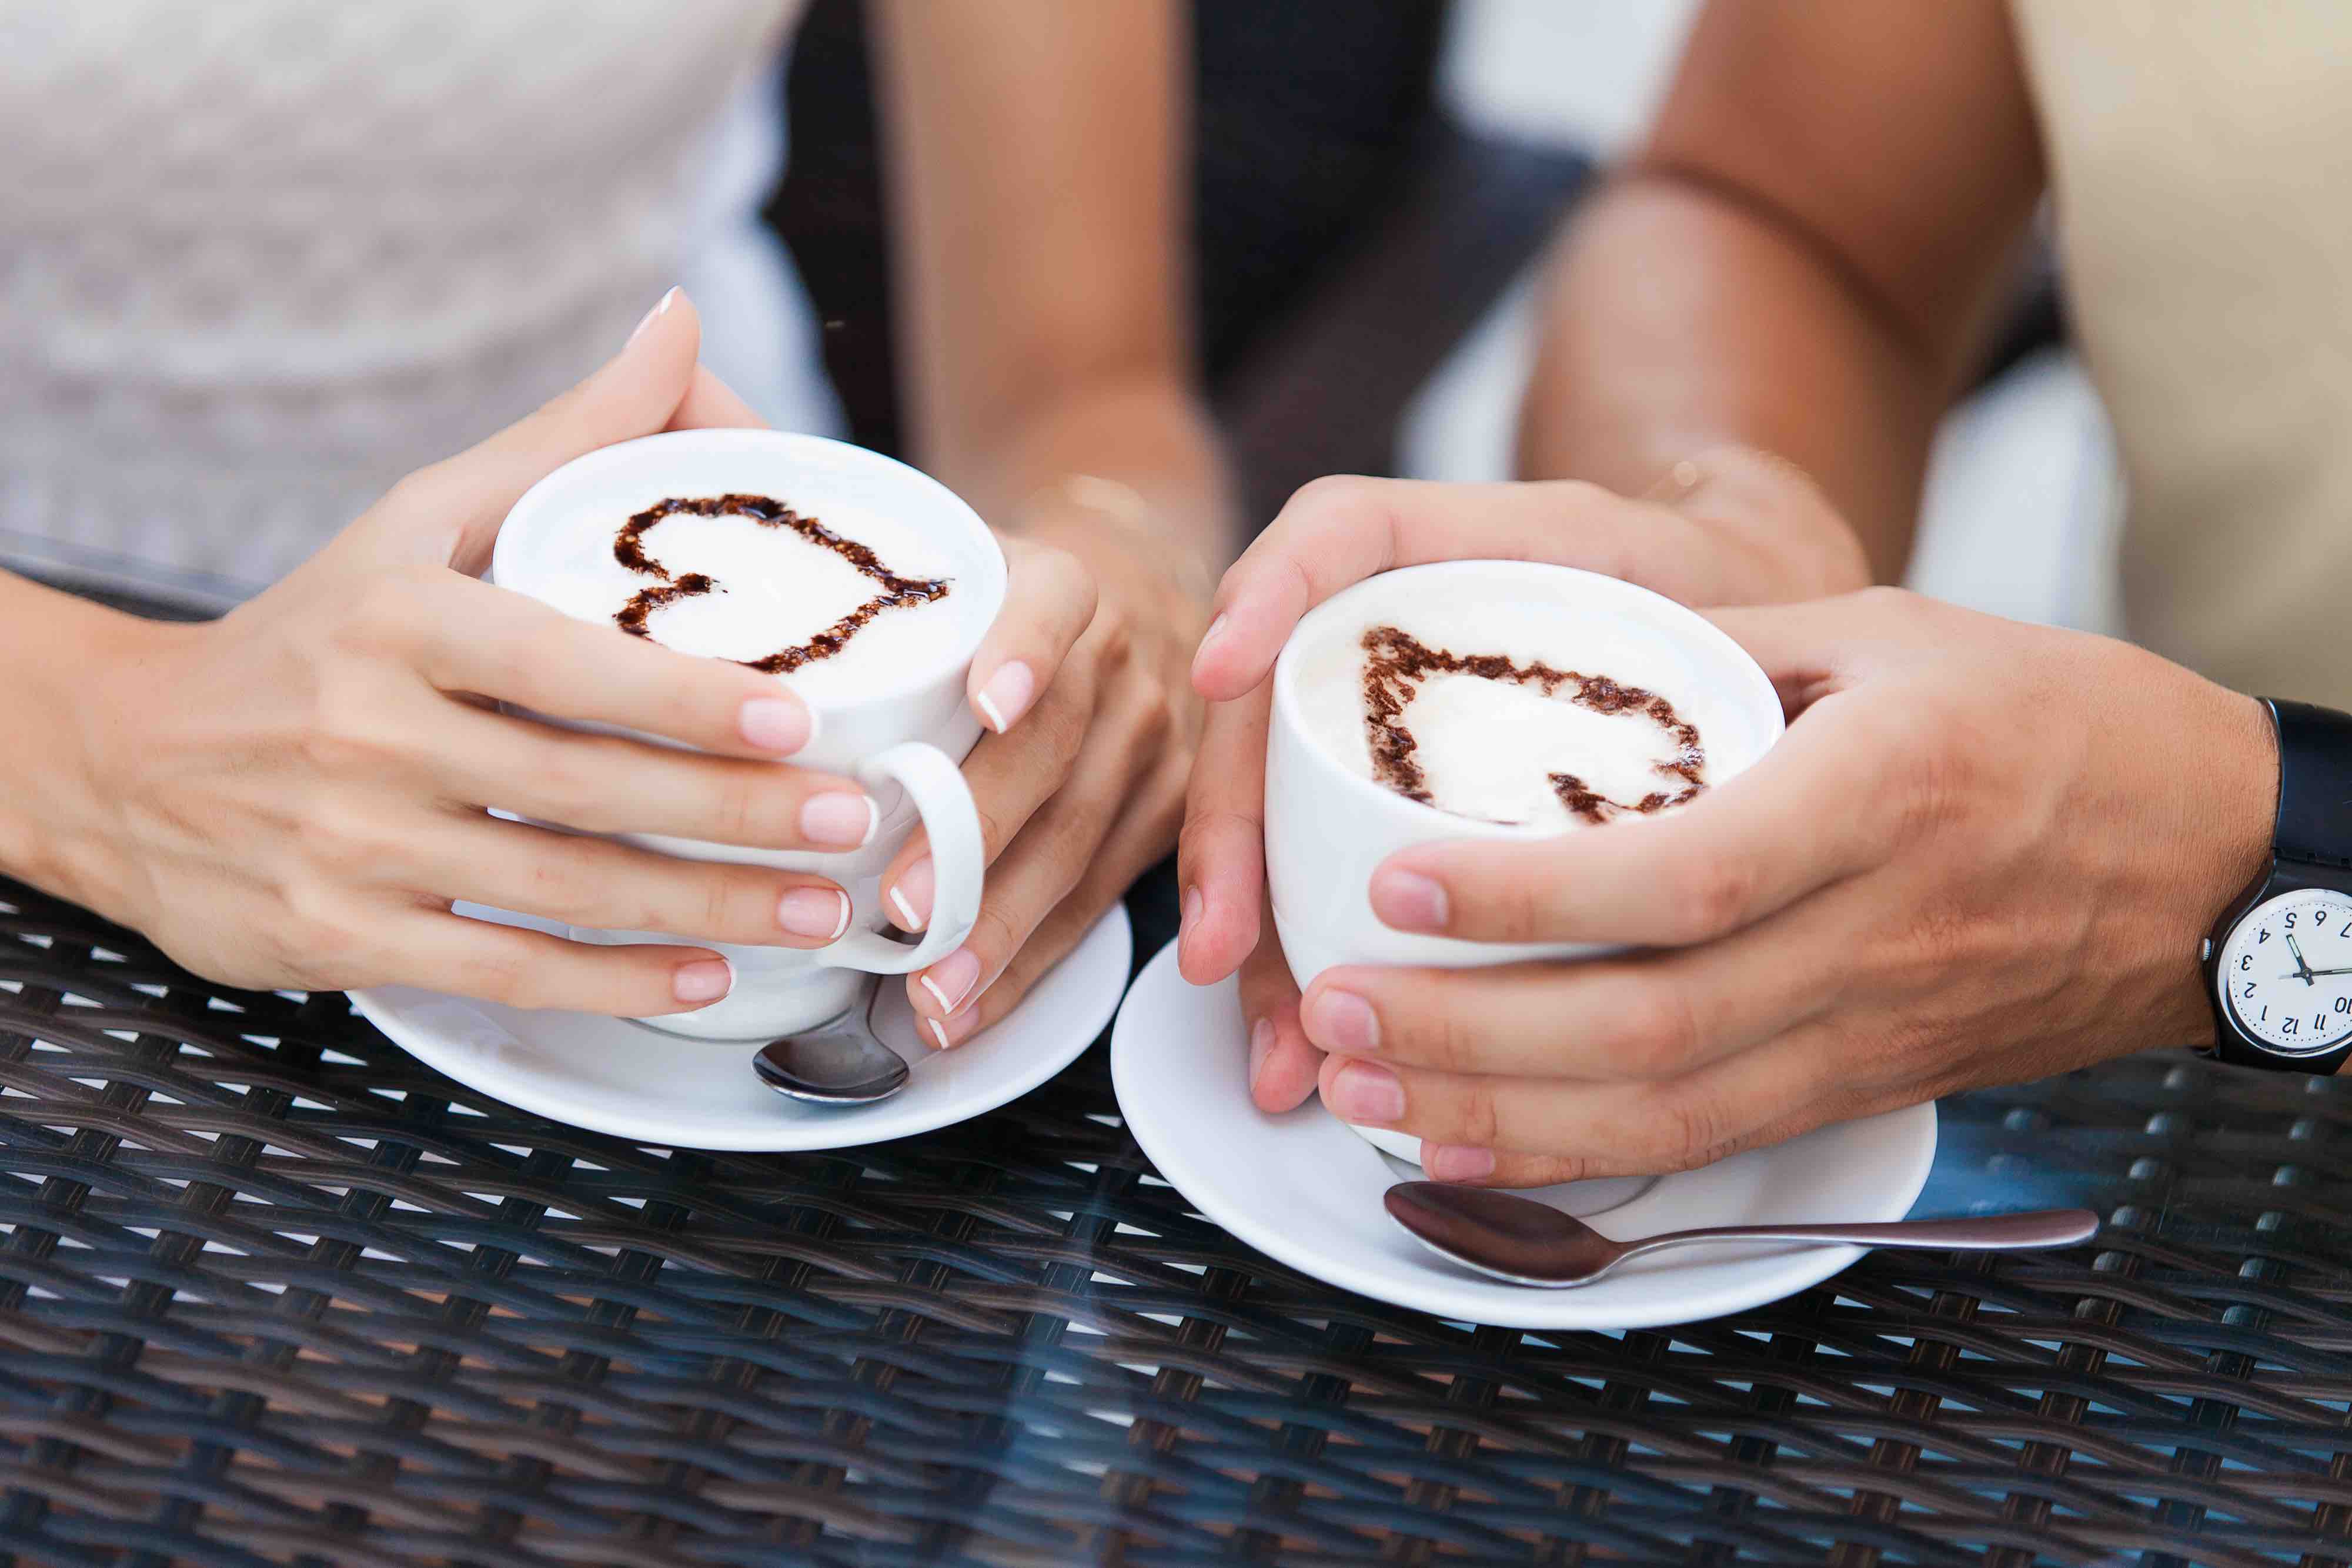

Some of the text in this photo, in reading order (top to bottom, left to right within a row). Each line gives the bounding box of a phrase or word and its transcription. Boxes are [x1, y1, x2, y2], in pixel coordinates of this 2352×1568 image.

[2284, 912, 2297, 928] 5
[2315, 911, 2327, 926] 6
[2259, 928, 2271, 944] 4
[2340, 922, 2352, 938] 7
[2241, 955, 2253, 971] 3
[2244, 982, 2257, 998] 2
[2261, 1005, 2267, 1021] 1
[2335, 997, 2352, 1014] 10
[2282, 1017, 2299, 1034] 12
[2314, 1014, 2326, 1030] 11
